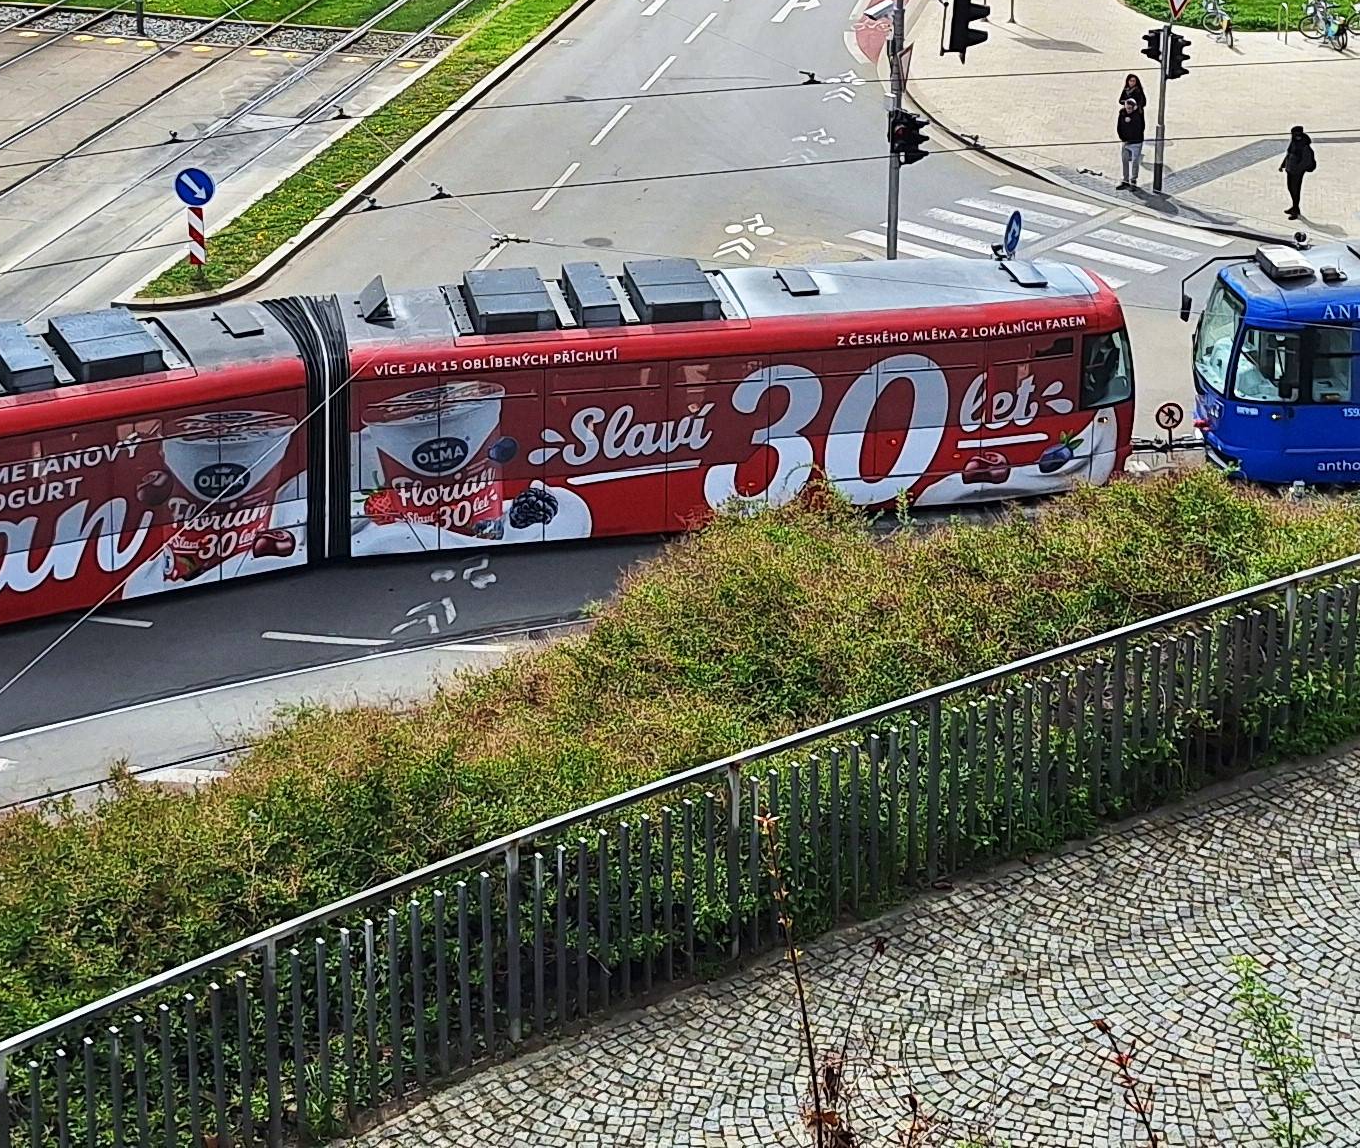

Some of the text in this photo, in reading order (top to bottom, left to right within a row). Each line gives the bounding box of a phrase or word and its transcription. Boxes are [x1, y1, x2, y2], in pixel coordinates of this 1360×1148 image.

[837, 316, 1086, 346] Z ČESKÉHO MLÉKA Z LOKÁLNÍCH FAREM
[374, 347, 618, 376] VÍCE JAK 15 OBLÍBENÝCH PŘÍCHUTÍ
[562, 402, 714, 466] Slaví
[703, 353, 1038, 516] 30 let
[417, 445, 465, 464] OLMA
[198, 475, 245, 488] OLMA
[392, 467, 496, 507] Florian
[168, 497, 268, 532] Florian
[439, 500, 472, 530] 30
[473, 495, 489, 512] let
[199, 531, 238, 560] 30
